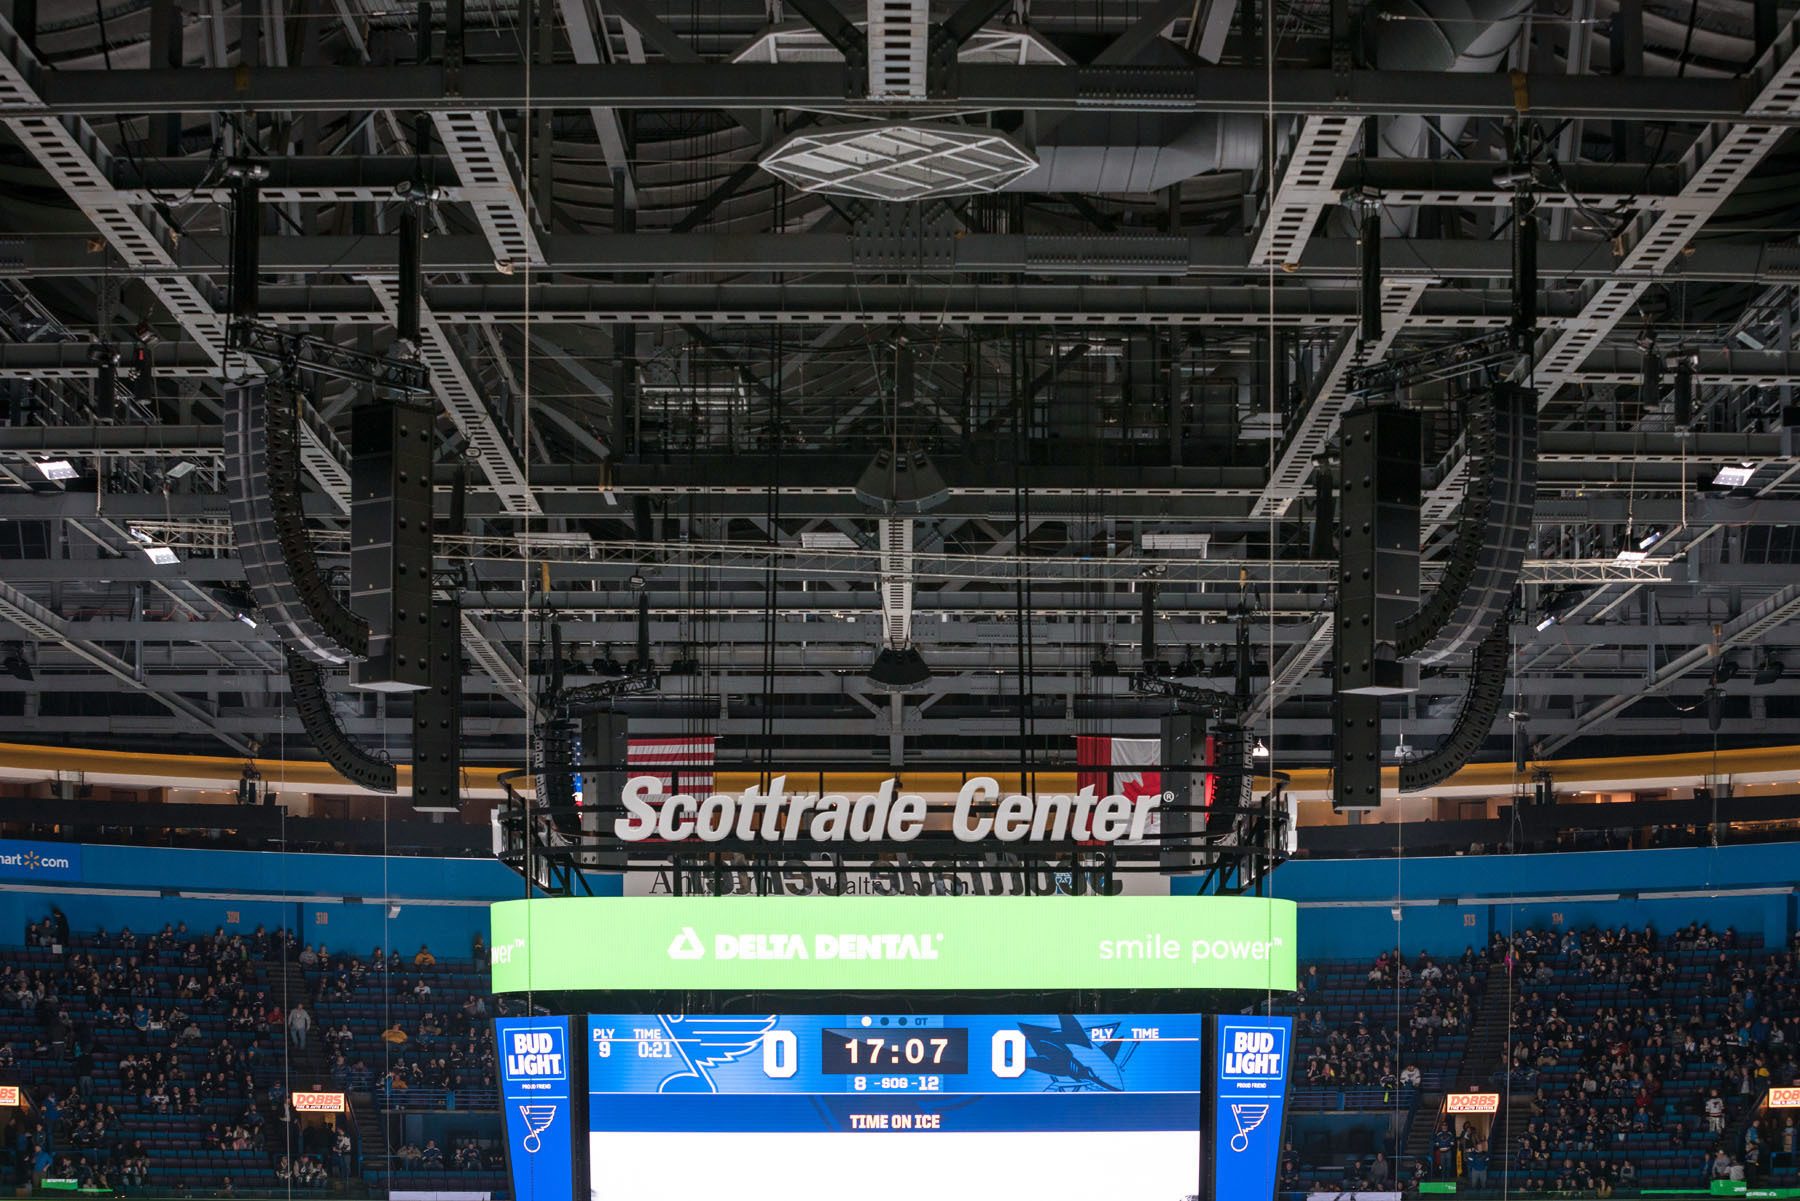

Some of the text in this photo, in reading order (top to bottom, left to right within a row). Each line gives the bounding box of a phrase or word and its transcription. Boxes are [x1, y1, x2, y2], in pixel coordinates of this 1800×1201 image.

[614, 775, 927, 842] Scottrade
[715, 933, 809, 960] DELTA
[1099, 934, 1181, 960] smile
[915, 1017, 928, 1026] OT
[513, 1033, 553, 1055] BUD
[593, 1028, 661, 1039] PLY TIME
[1091, 1028, 1159, 1039] PLY TIME
[1234, 1031, 1274, 1053] BUD
[599, 1041, 672, 1058] 9 0:21
[763, 1030, 797, 1078] 0
[844, 1038, 948, 1064] 17:07
[992, 1030, 1026, 1078] 0
[508, 1054, 562, 1075] LIGHT
[1225, 1052, 1281, 1074] LIGHT
[854, 1076, 867, 1091] 8
[295, 1094, 342, 1105] DOBBS
[1451, 1095, 1497, 1106] DOBBS
[850, 1114, 940, 1129] TIME ON ICE
